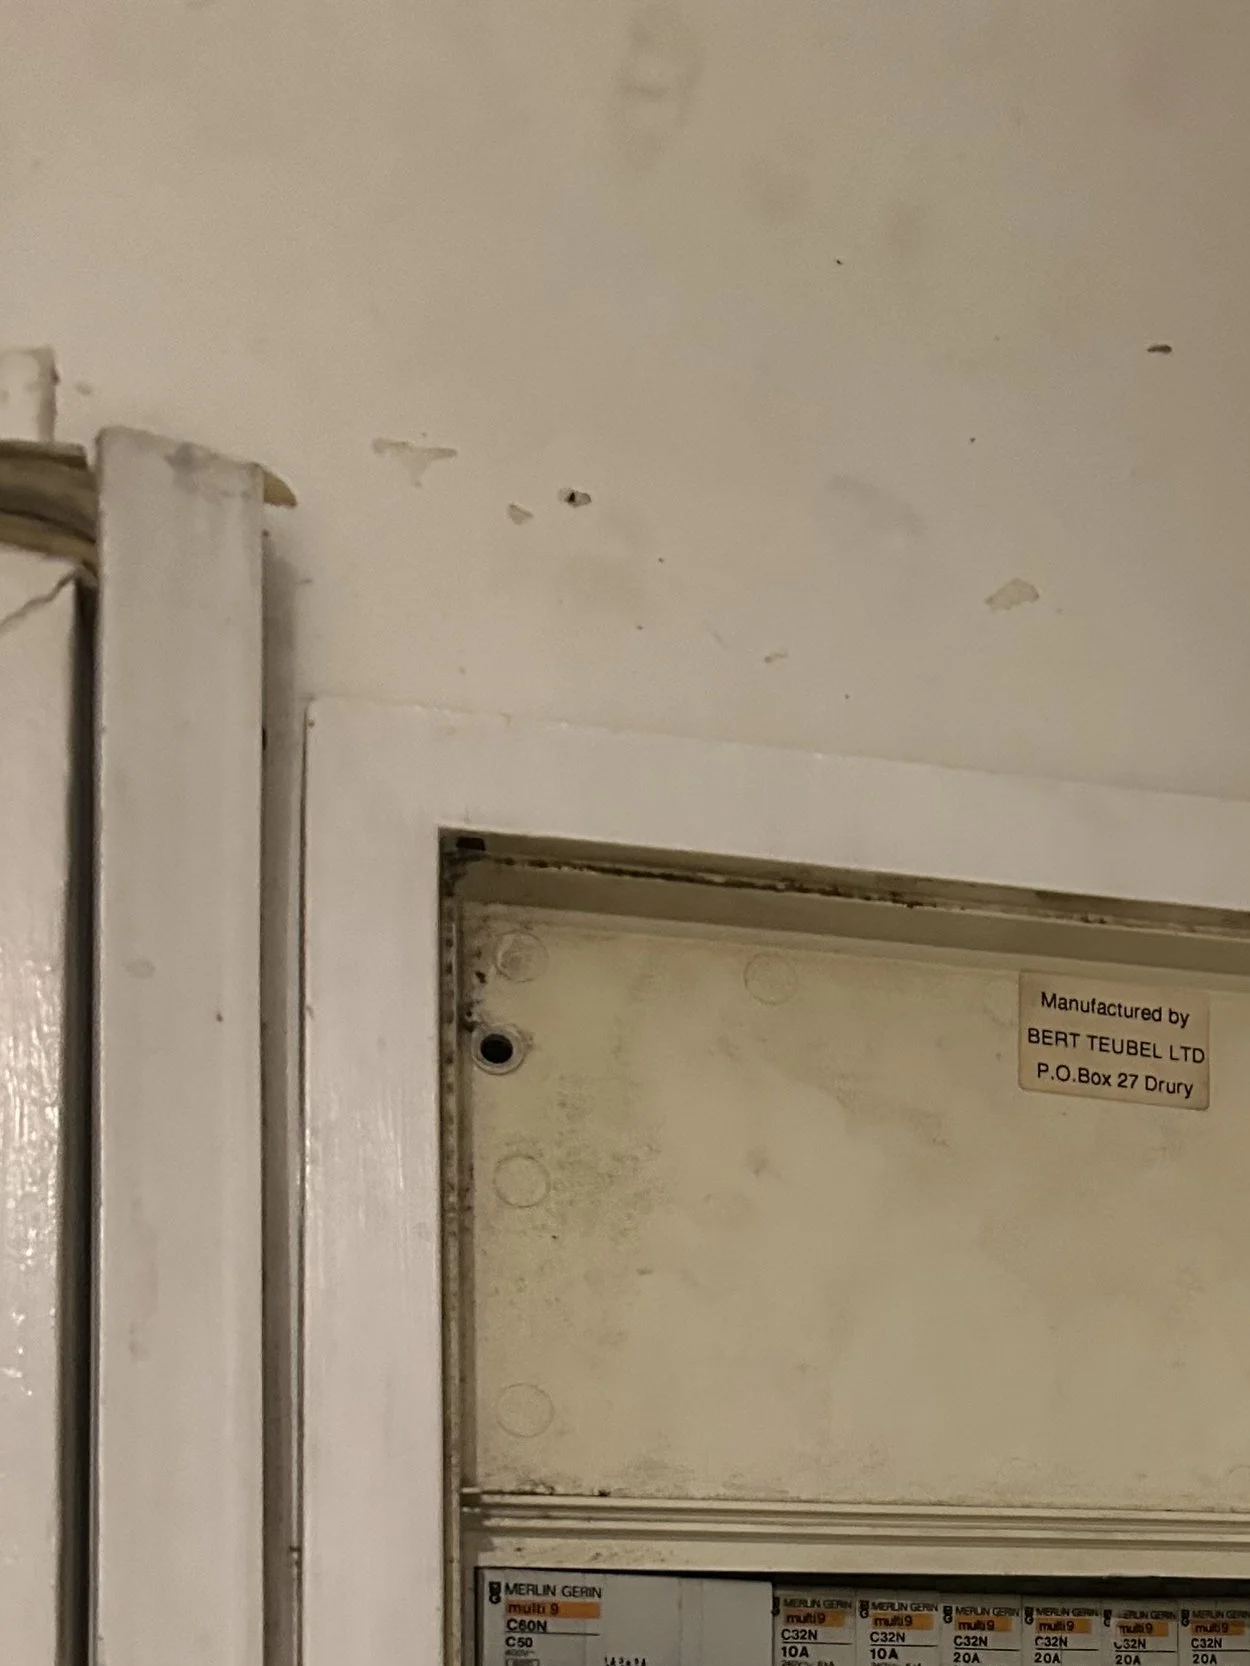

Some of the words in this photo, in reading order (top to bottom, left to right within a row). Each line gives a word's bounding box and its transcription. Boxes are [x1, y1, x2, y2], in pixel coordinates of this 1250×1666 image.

[1041, 992, 1162, 1022] Manufactured
[1168, 1008, 1190, 1028] by
[1027, 1028, 1080, 1049] BERT
[1087, 1034, 1162, 1059] TEUBEL
[1169, 1045, 1205, 1064] LTD
[1036, 1063, 1112, 1087] P.O.Box
[1117, 1073, 1139, 1089] 27
[1145, 1075, 1193, 1099] Drury
[504, 1582, 556, 1597] MERLIN
[561, 1585, 602, 1599] GERIN
[506, 1618, 548, 1632] C60N
[781, 1629, 818, 1641] C32N
[869, 1631, 906, 1643] C32N
[505, 1636, 534, 1648] C50
[953, 1635, 989, 1648] C32N
[1034, 1636, 1068, 1647] C32N
[1191, 1638, 1223, 1649] C32N
[781, 1646, 810, 1658] 10A
[870, 1647, 899, 1660] 10A
[953, 1652, 981, 1664] 20A
[1034, 1652, 1061, 1664] 20A
[1114, 1654, 1142, 1666] 20A
[1192, 1654, 1218, 1665] 20A
